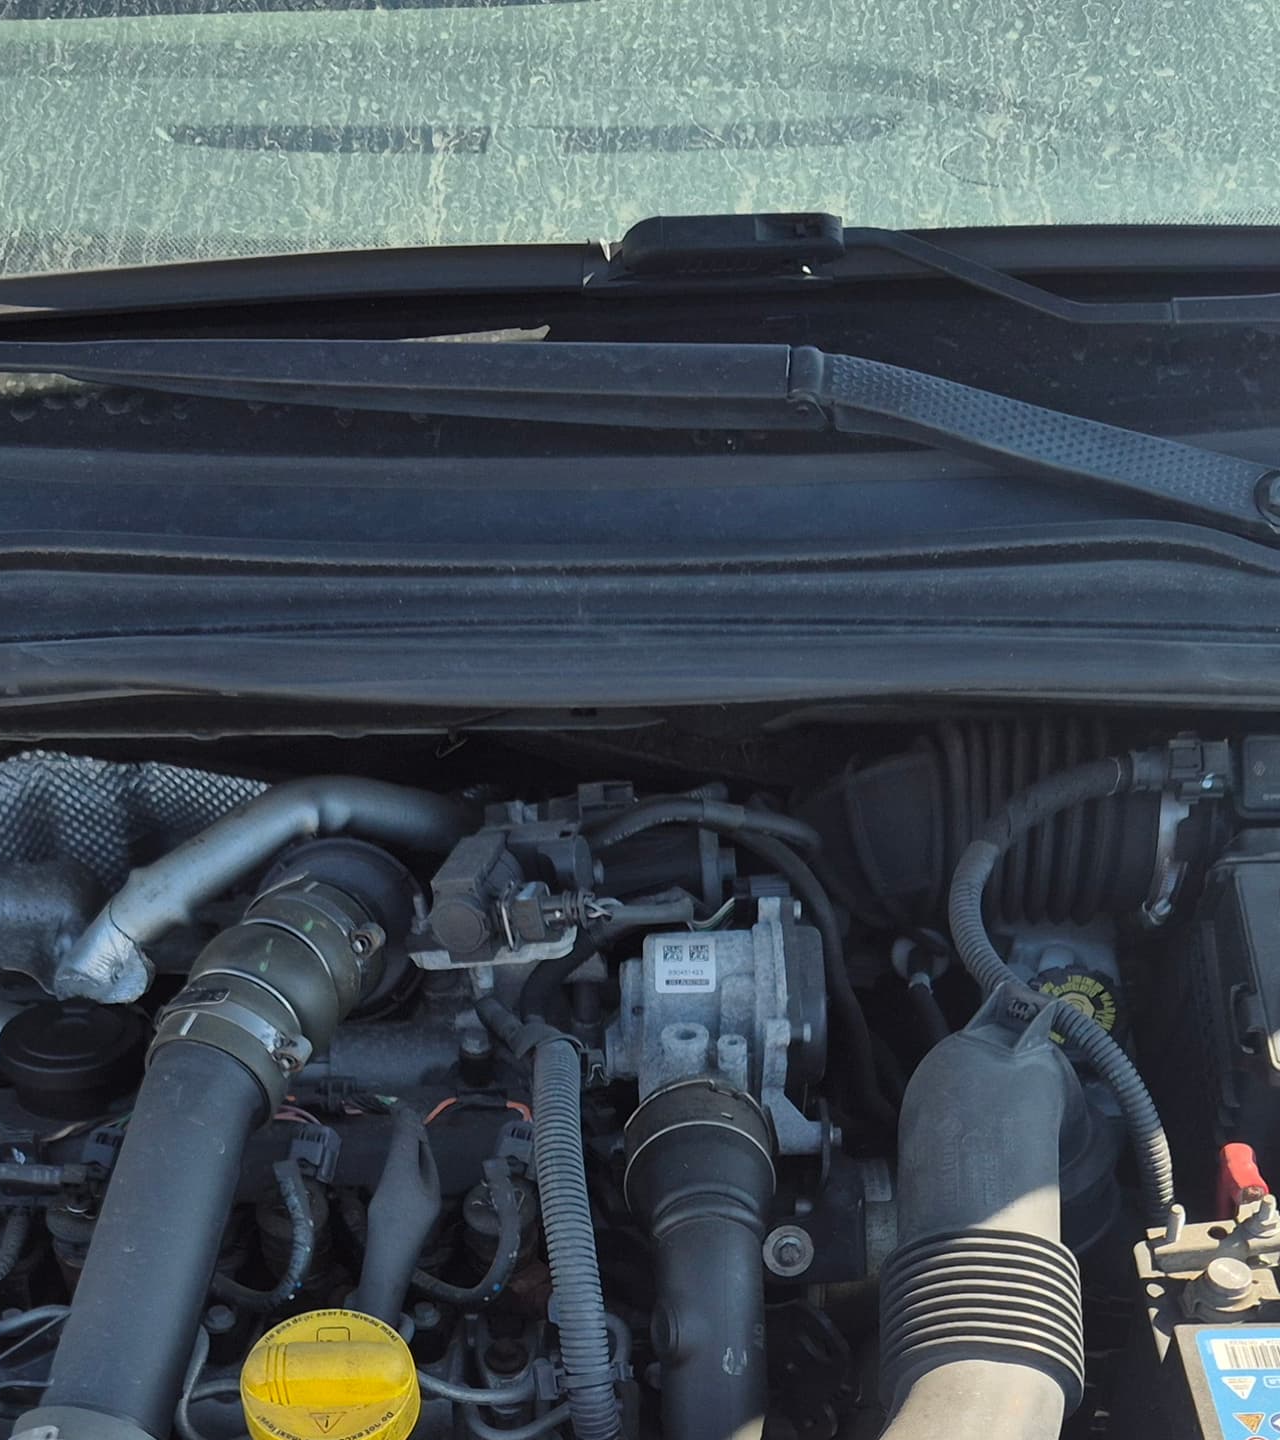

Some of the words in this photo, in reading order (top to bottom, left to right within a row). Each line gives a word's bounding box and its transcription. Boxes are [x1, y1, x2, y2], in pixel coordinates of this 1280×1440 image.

[351, 1312, 379, 1327] niveau
[380, 1323, 398, 1342] maxi
[380, 1411, 395, 1424] Do
[365, 1420, 381, 1436] not
